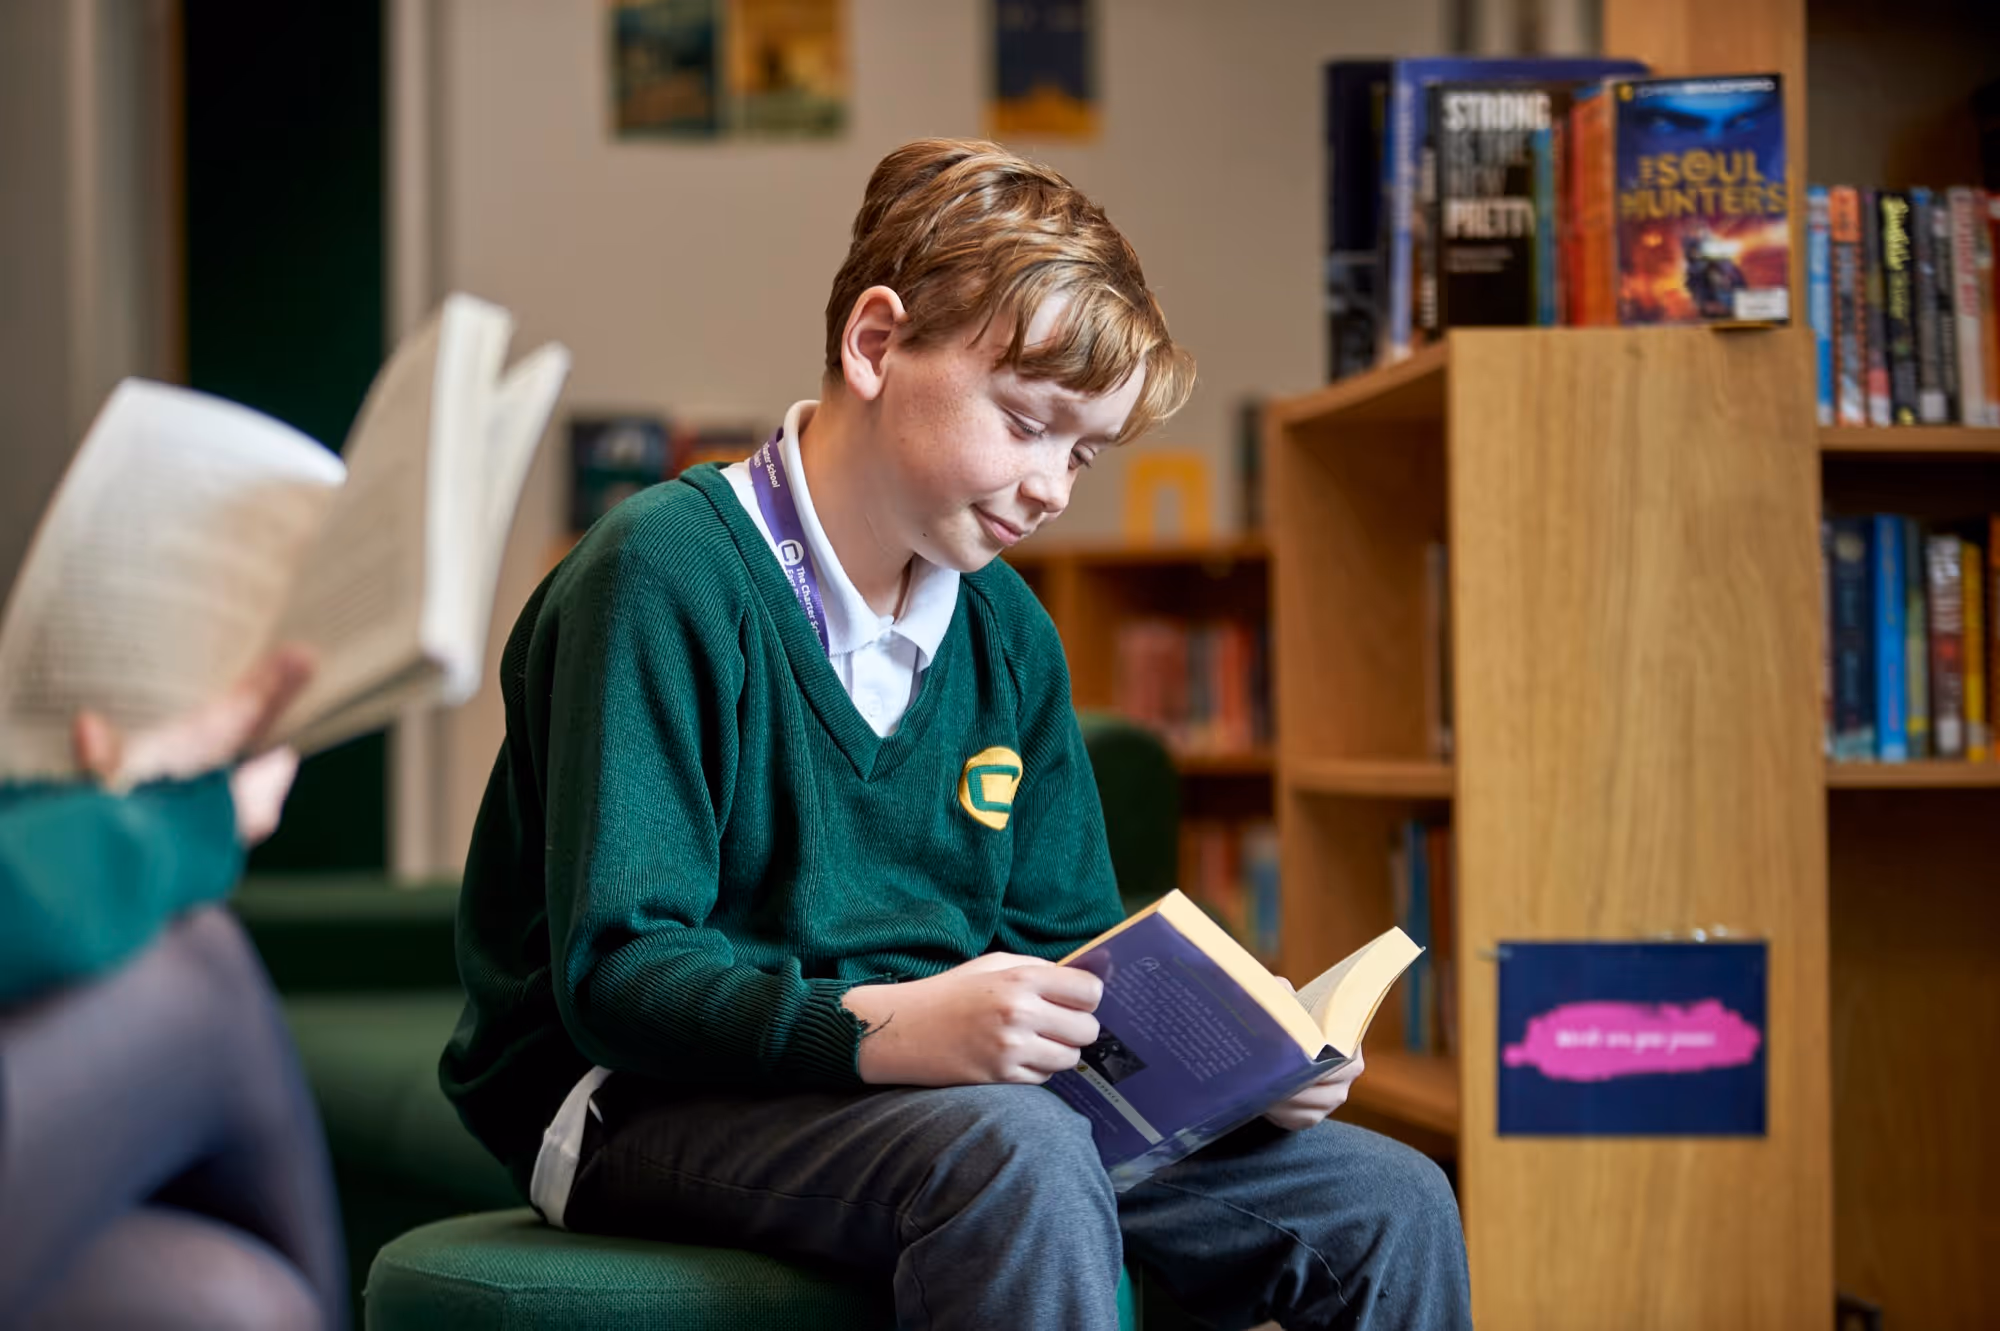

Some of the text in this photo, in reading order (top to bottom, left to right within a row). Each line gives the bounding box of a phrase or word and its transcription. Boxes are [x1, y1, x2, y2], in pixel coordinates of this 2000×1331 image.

[1442, 91, 1551, 130] STRONG
[1656, 150, 1767, 190] SOUL
[1443, 197, 1536, 239] PRETTY
[1621, 181, 1786, 221] HUNTERS
[766, 463, 780, 488] School
[796, 566, 806, 584] The
[801, 584, 816, 620] Charter
